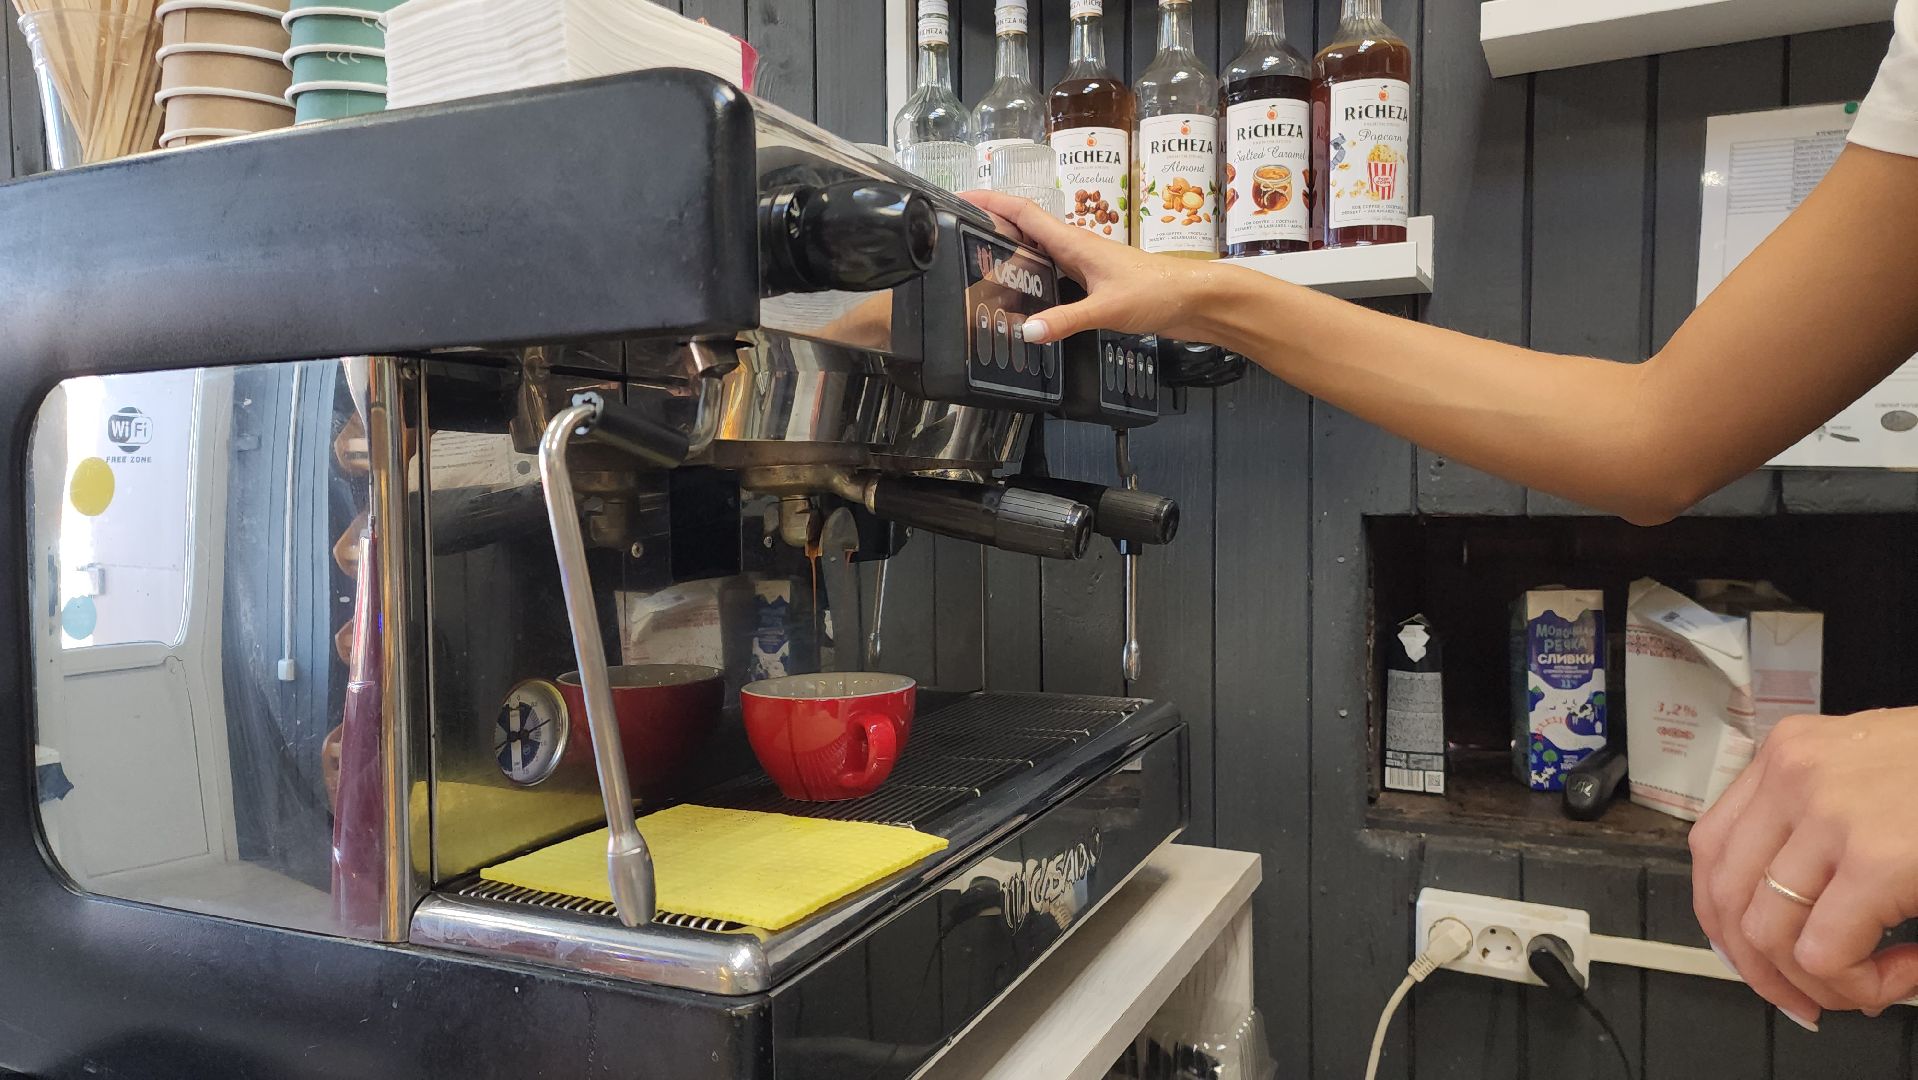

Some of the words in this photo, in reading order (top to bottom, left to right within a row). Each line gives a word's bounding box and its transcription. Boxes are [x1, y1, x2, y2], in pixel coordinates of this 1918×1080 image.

[1345, 104, 1408, 122] RiCHEZA
[1237, 123, 1303, 141] RiCHEZA
[1358, 128, 1403, 144] Popcorn
[1150, 138, 1213, 155] RiCHEZA
[1234, 145, 1265, 164] Salted
[1267, 145, 1307, 161] Caramel
[1059, 150, 1121, 166] RiCHEZA
[1161, 161, 1206, 174] Almond
[1066, 172, 1116, 184] Hazelnut
[994, 259, 1043, 298] CASADIO
[130, 456, 152, 464] ZONE
[1544, 638, 1587, 653] РЕЧКА
[1537, 653, 1595, 665] СЛИВКИ
